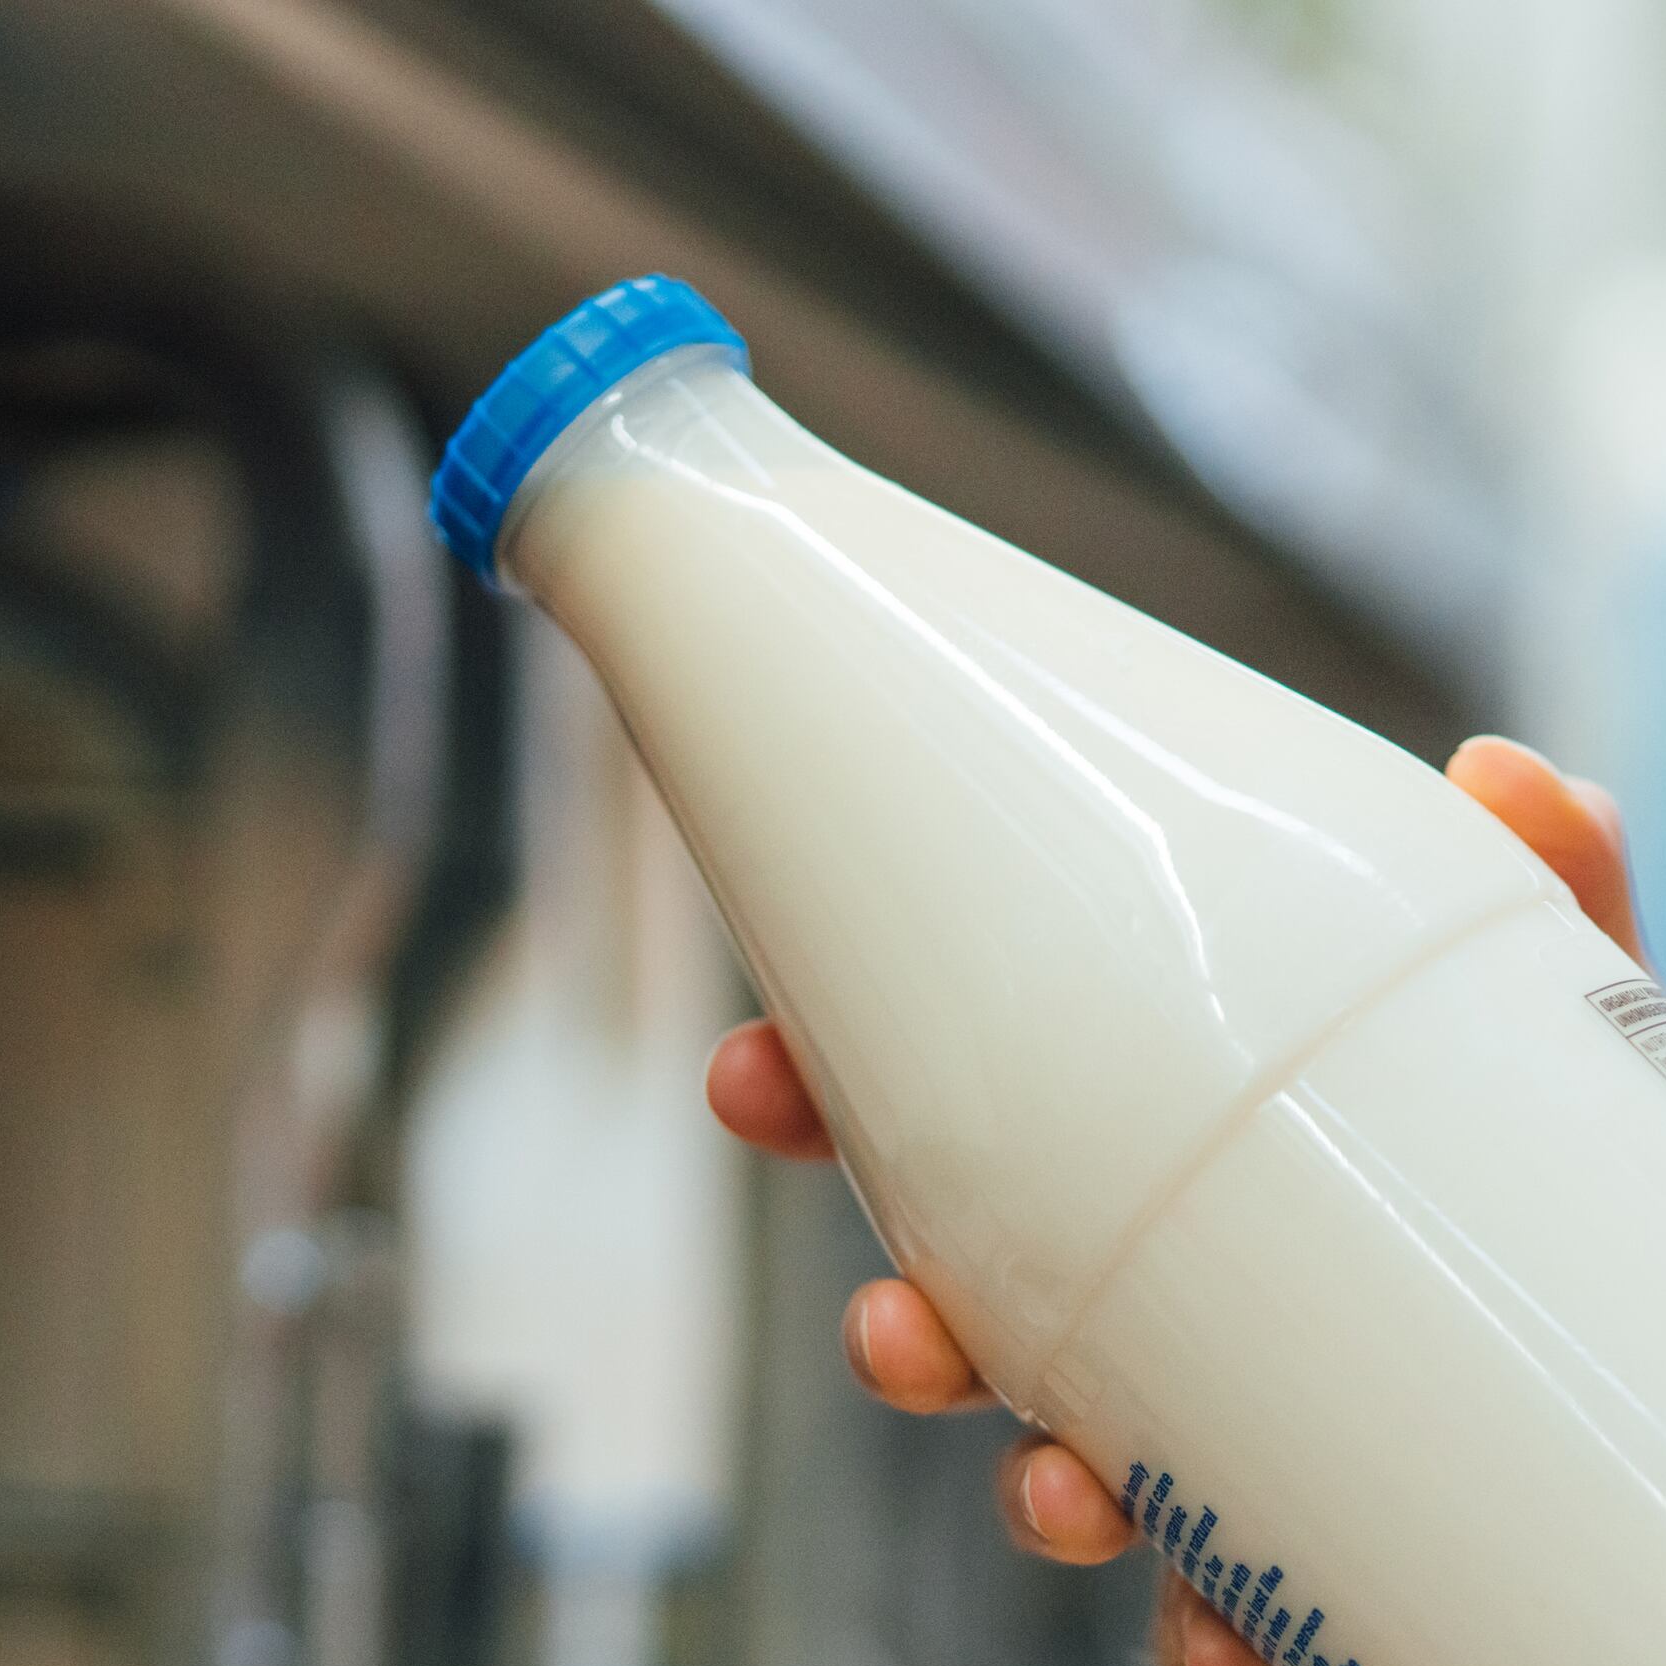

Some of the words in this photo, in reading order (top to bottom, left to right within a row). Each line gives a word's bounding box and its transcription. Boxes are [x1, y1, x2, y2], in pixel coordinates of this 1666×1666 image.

[1123, 1460, 1150, 1499] family
[1153, 1472, 1175, 1503] care
[1189, 1505, 1219, 1555] natural
[1204, 1555, 1224, 1578] Our
[1231, 1563, 1252, 1593] with
[1258, 1565, 1284, 1594] like
[1247, 1586, 1270, 1620] just
[1268, 1607, 1292, 1642] when
[1293, 1608, 1326, 1657] person
